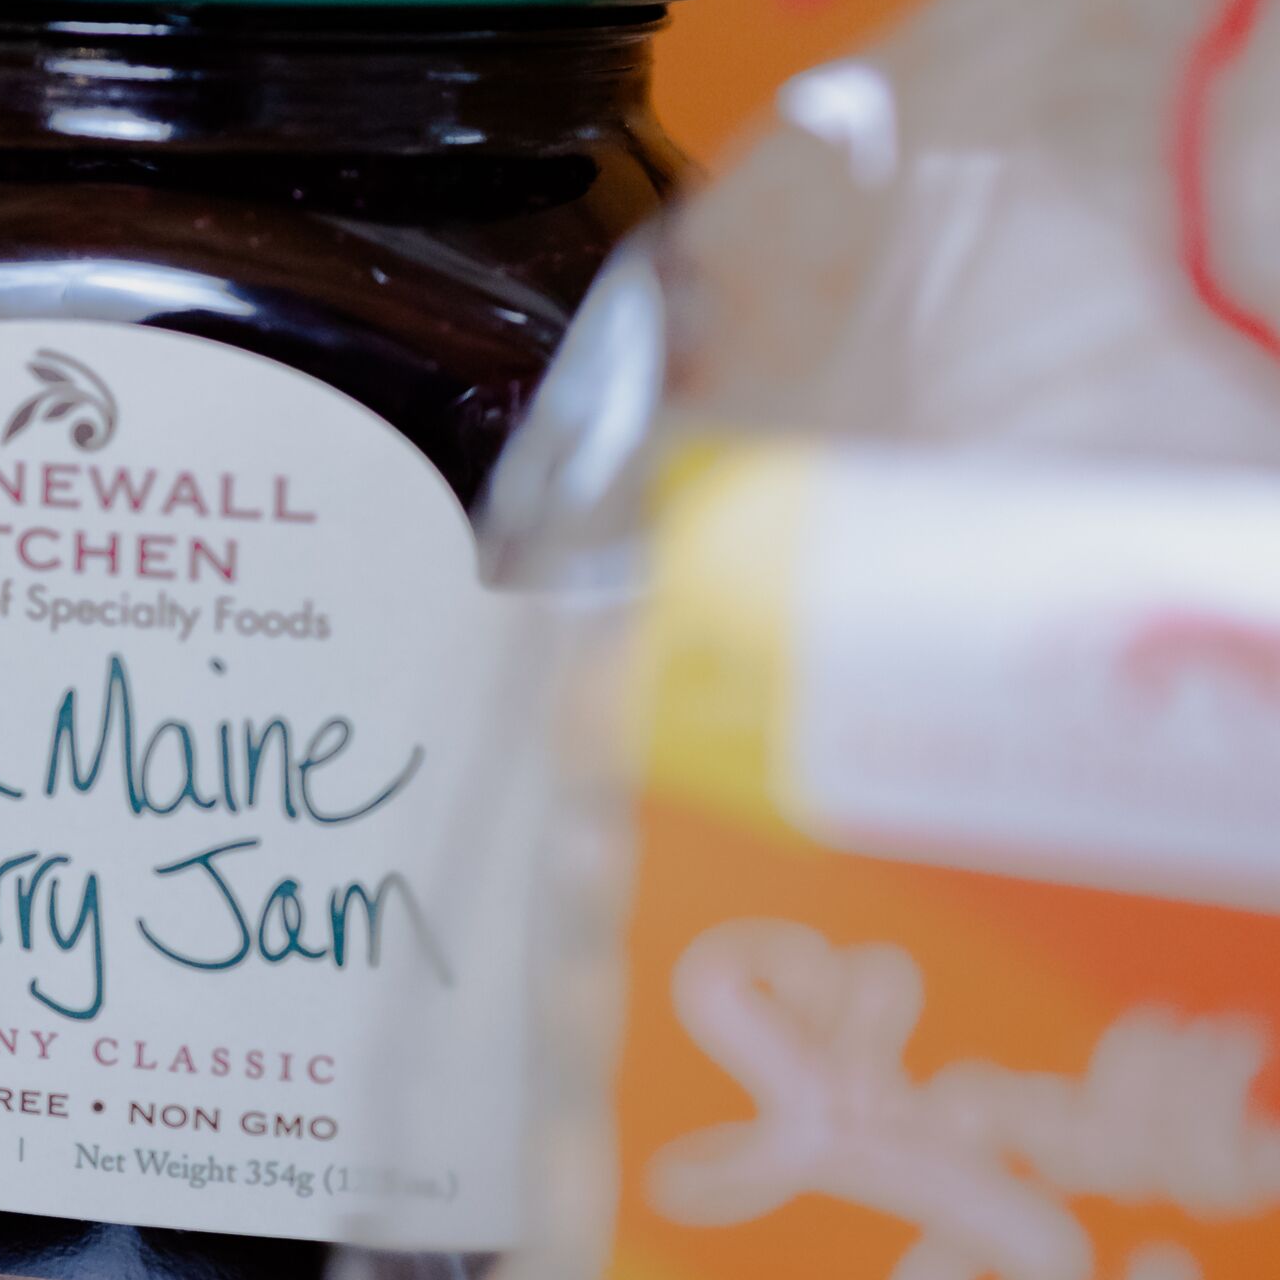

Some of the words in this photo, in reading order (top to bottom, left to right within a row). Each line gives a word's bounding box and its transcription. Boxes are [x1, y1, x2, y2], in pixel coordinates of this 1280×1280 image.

[26, 583, 203, 641] Specialty
[214, 598, 332, 641] Foods
[46, 653, 425, 824] Maine
[137, 836, 454, 989] Jam
[91, 1036, 338, 1087] CLASSIC
[128, 1100, 222, 1134] NON
[239, 1111, 339, 1142] GMO
[75, 1143, 126, 1175] Net
[134, 1147, 238, 1190] Weight
[244, 1157, 316, 1199] 354g
